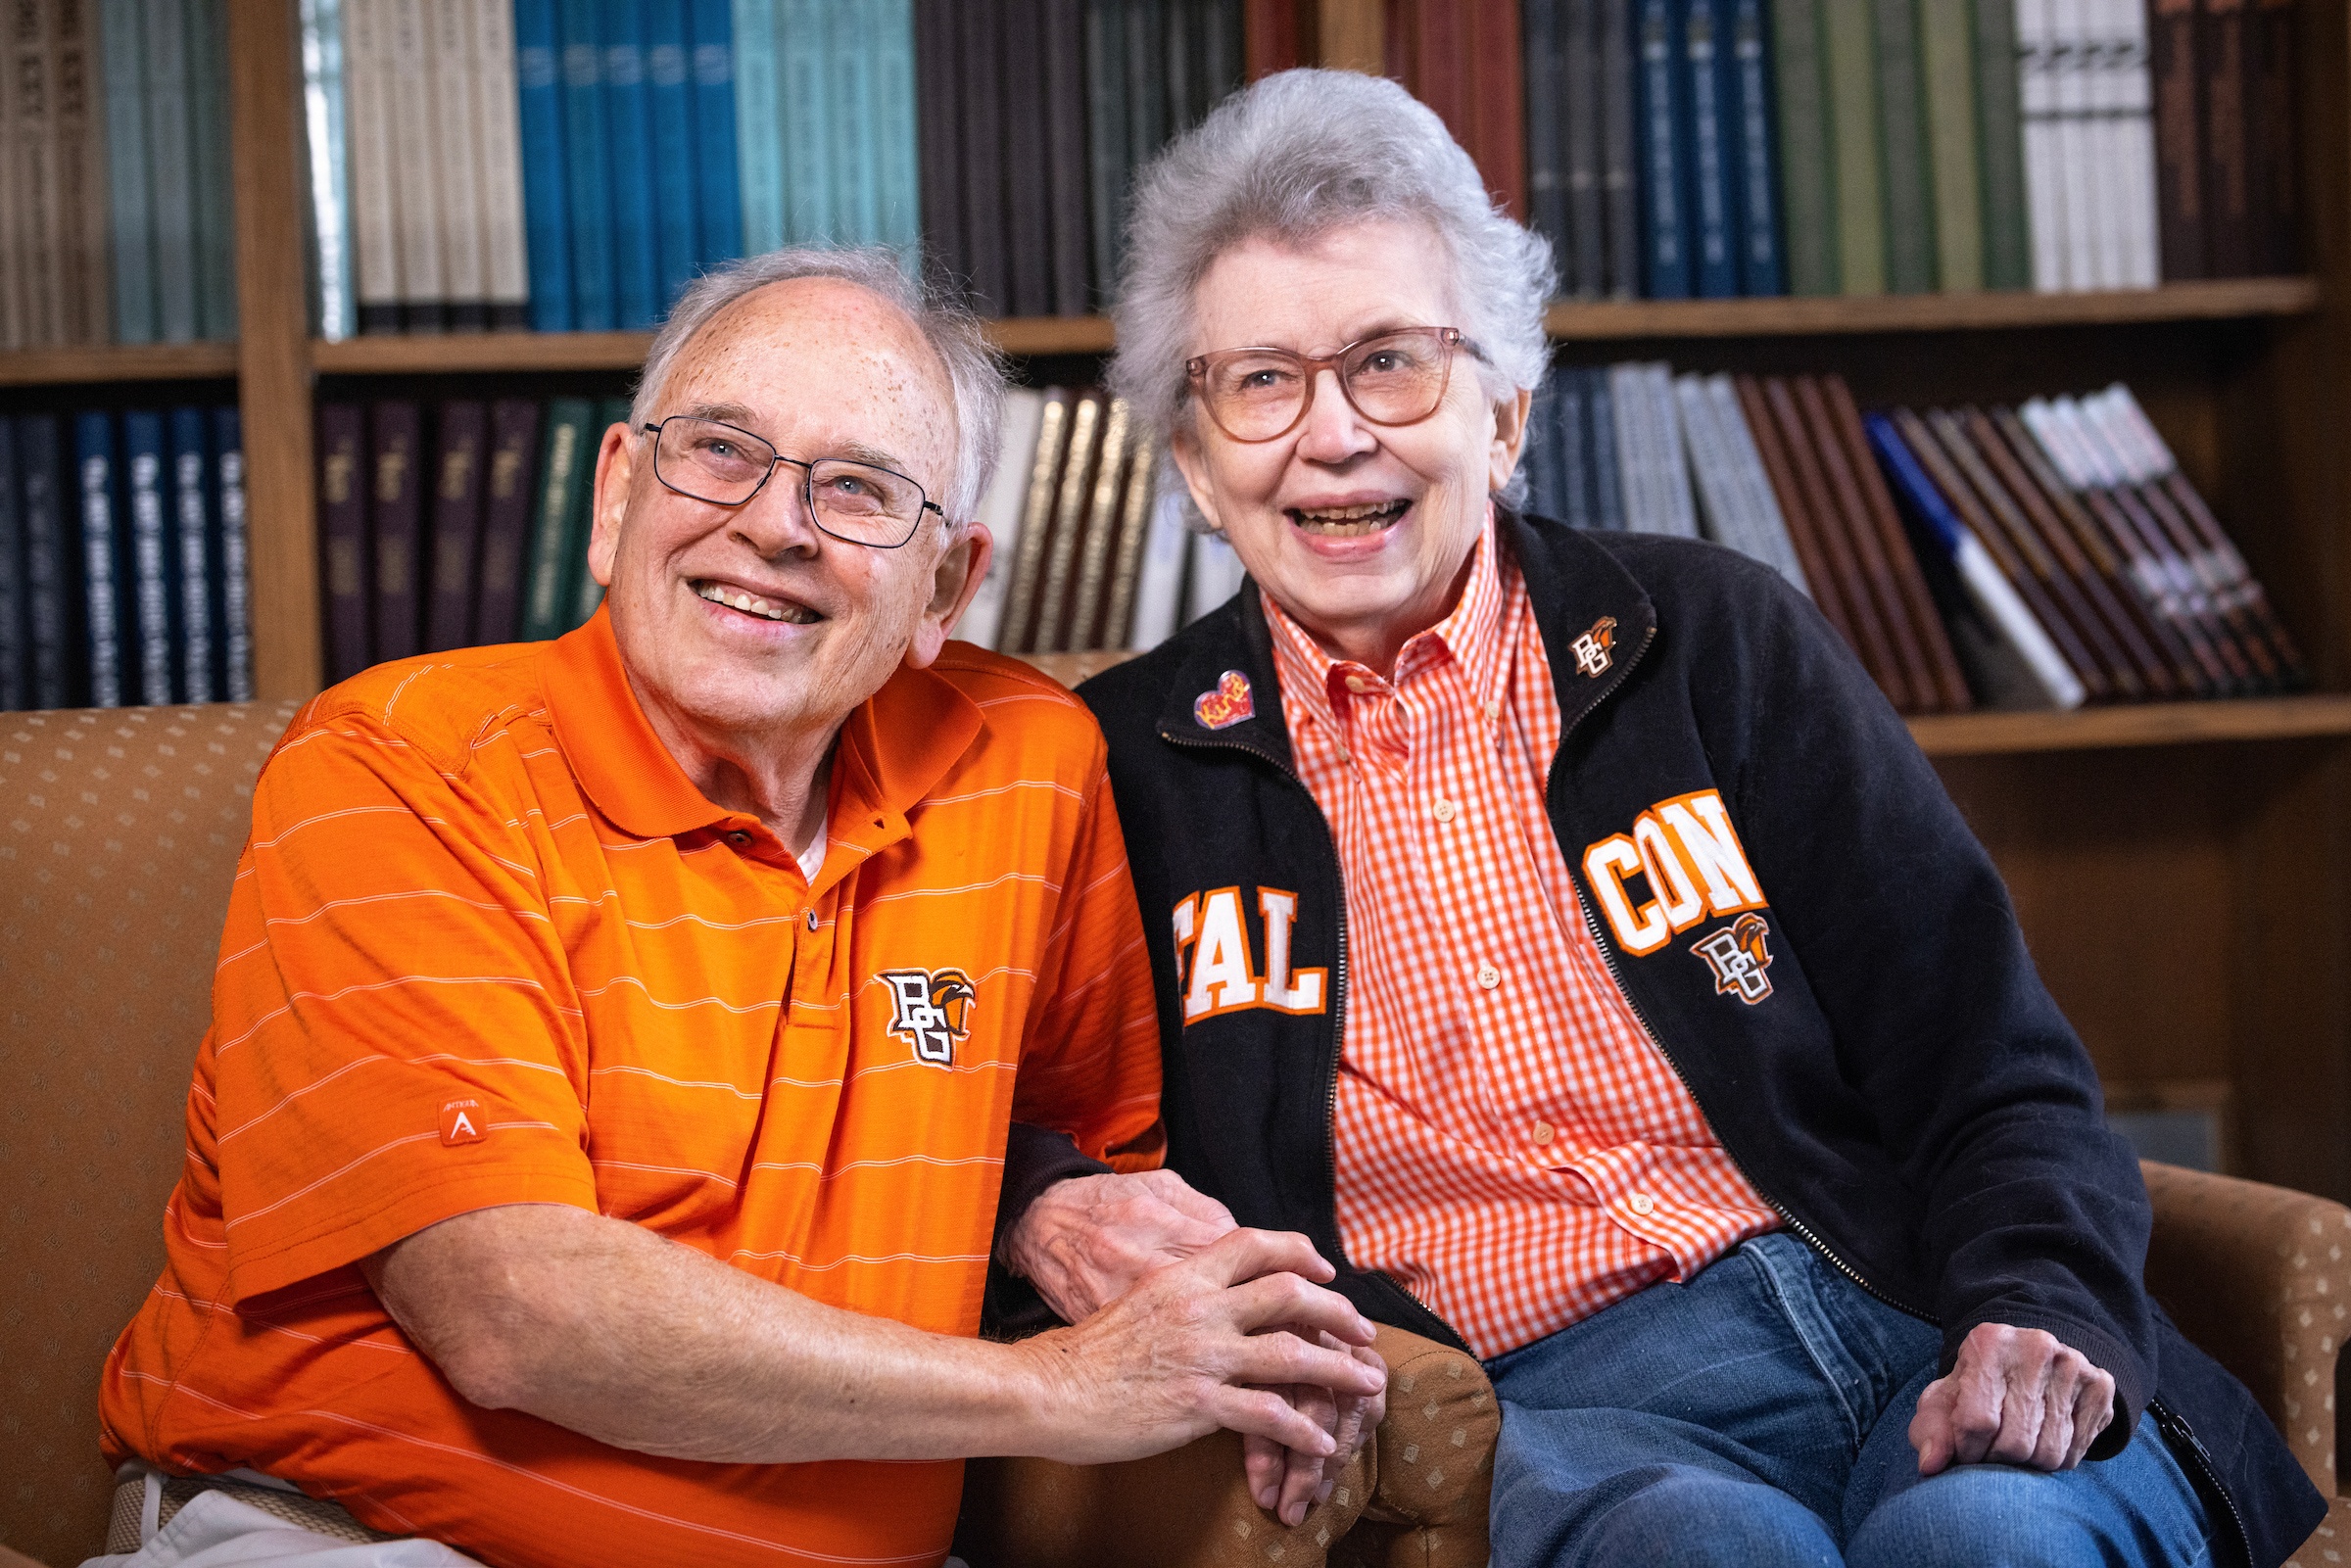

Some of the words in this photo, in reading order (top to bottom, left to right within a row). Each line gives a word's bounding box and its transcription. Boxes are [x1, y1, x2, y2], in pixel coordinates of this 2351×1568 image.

[1570, 632, 1609, 676] BG
[1582, 788, 1770, 957] CON
[1698, 931, 1768, 999] BG
[882, 972, 952, 1065] BG
